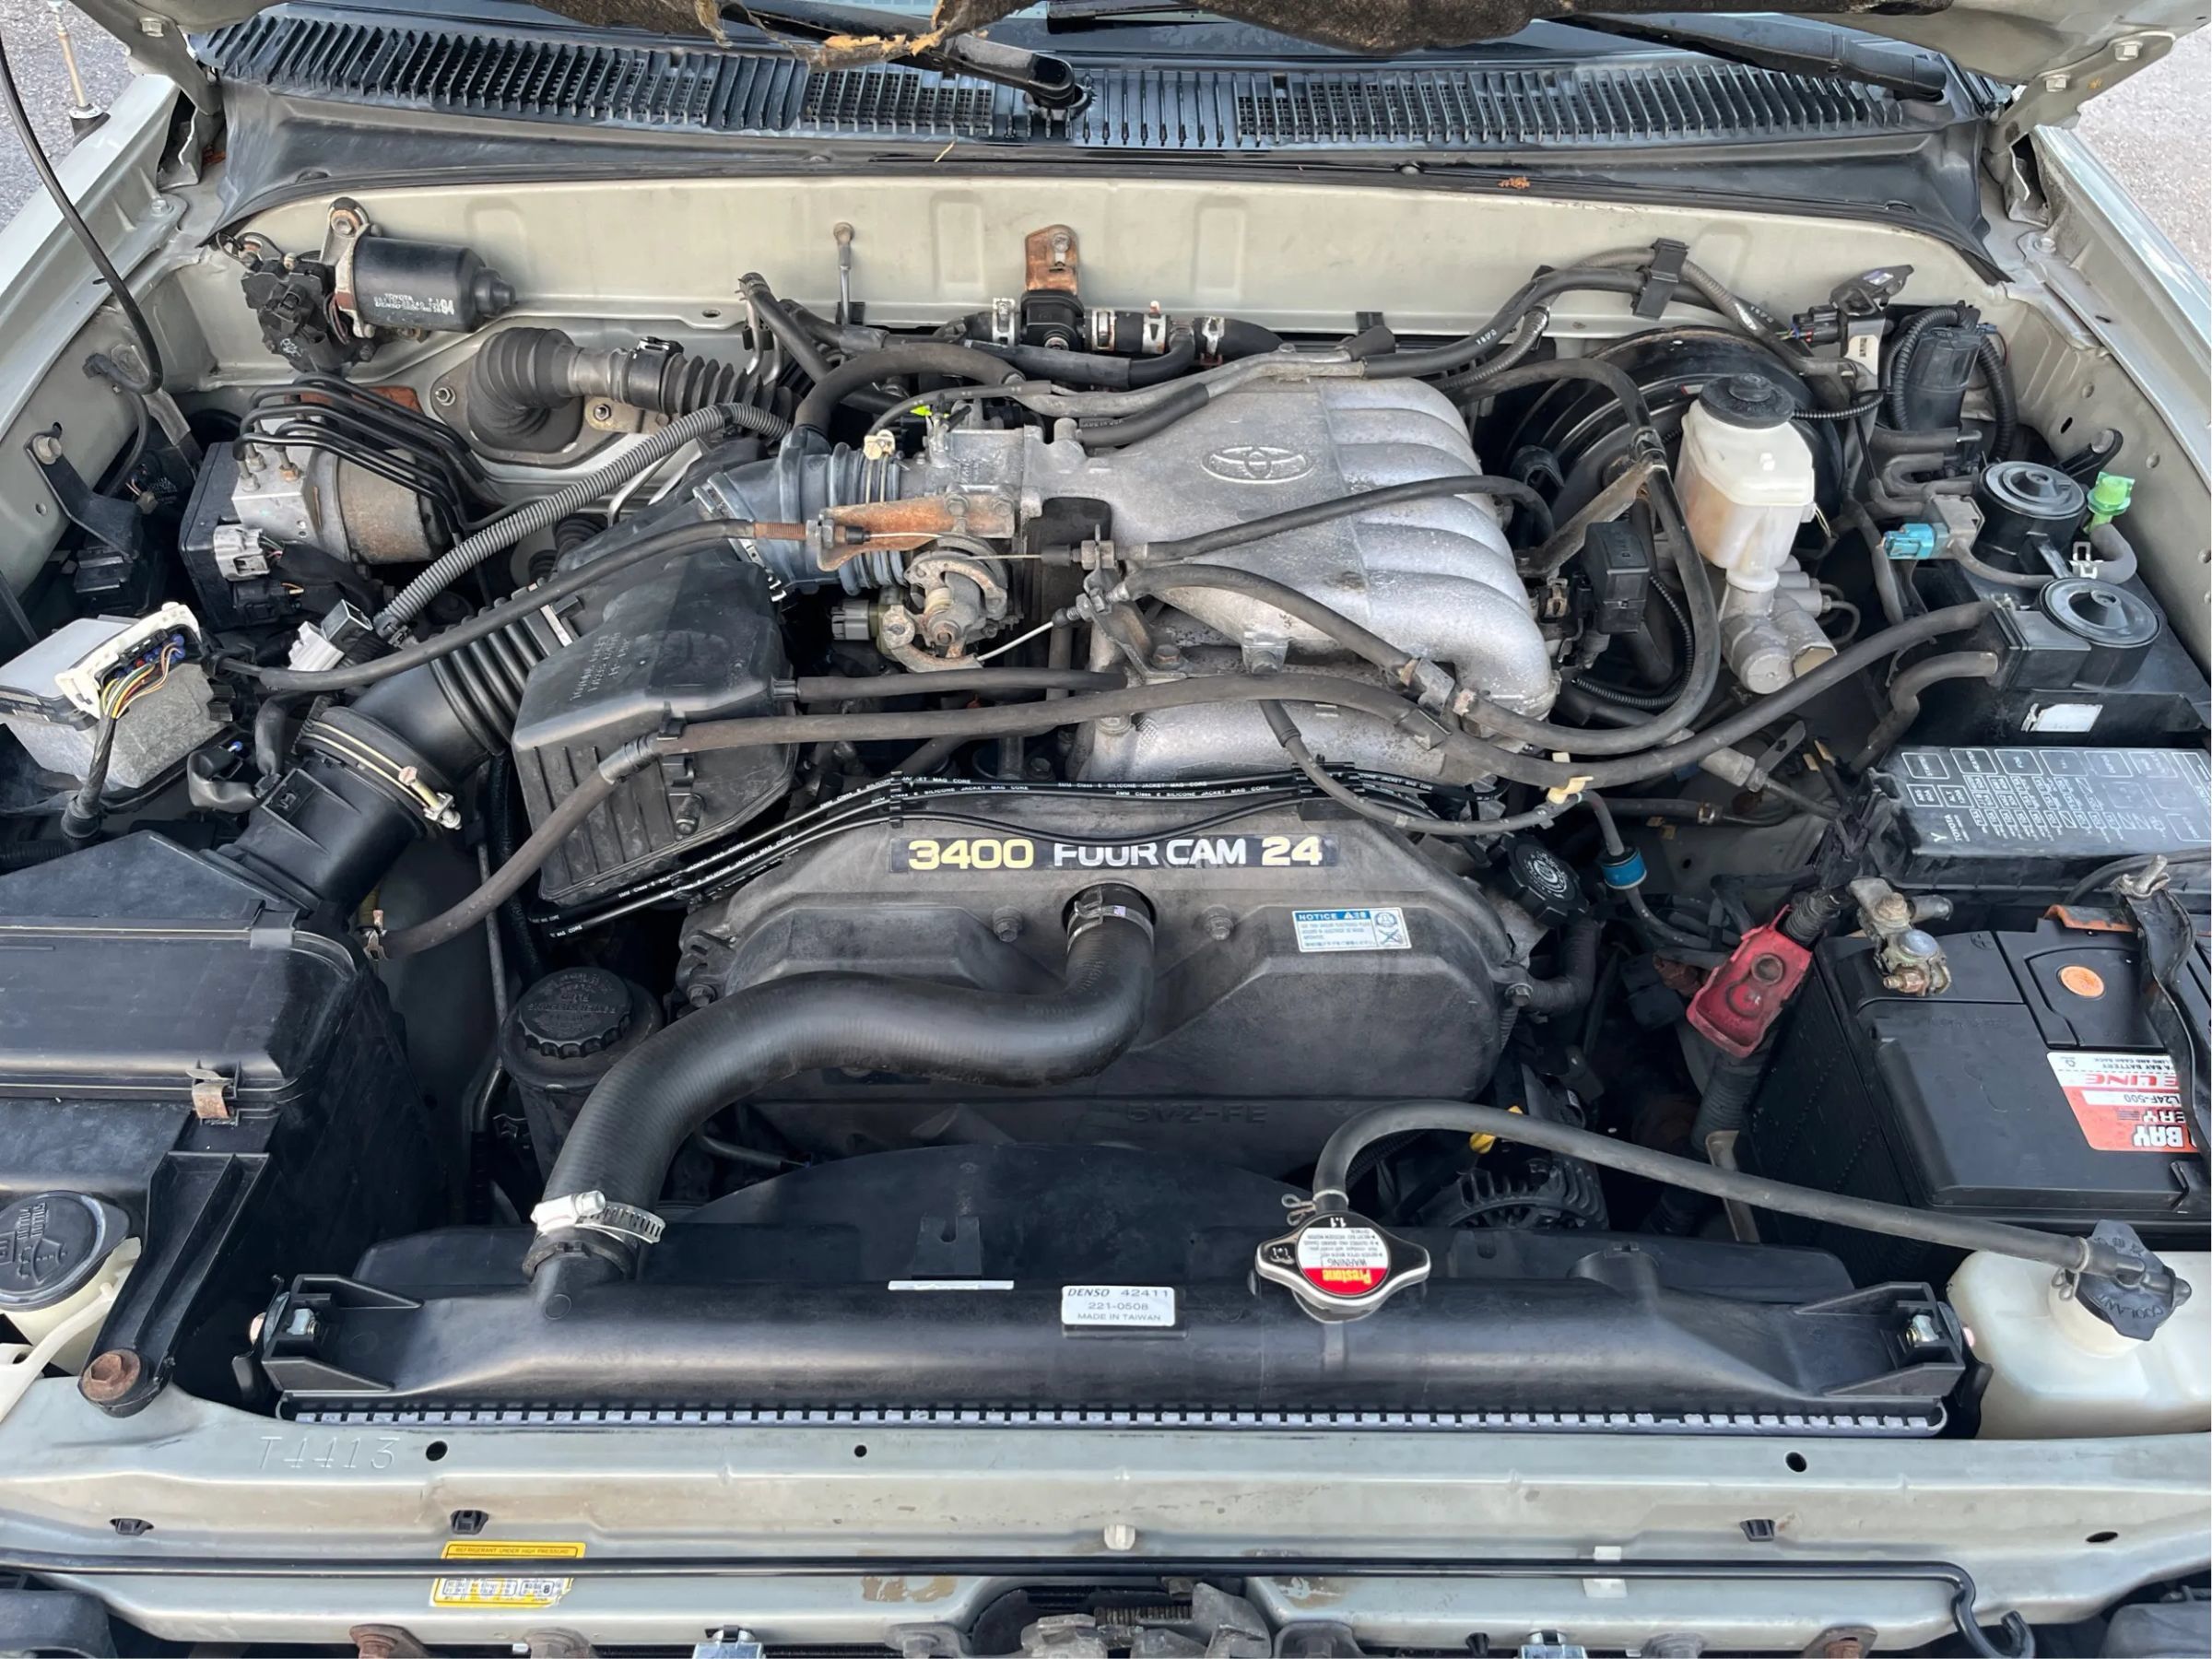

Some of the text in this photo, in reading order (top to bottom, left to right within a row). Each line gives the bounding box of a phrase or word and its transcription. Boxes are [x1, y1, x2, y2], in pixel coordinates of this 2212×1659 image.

[1944, 814, 1962, 841] TOYOTA
[908, 836, 1324, 870] 3400 FOUR CAM 24
[1298, 912, 1338, 921] NOTICE
[2085, 1073, 2157, 1086] LINE
[2133, 1125, 2184, 1148] BAY
[1330, 1218, 1347, 1228] 1.1
[1327, 1259, 1367, 1267] WARNING
[1322, 1269, 1371, 1285] Prestone
[1067, 1288, 1169, 1298] DENSO 42411
[1088, 1301, 1148, 1310] 221-0508
[2097, 1293, 2164, 1319] COOLANT
[260, 1436, 400, 1470] T4413
[543, 1582, 550, 1594] 8
